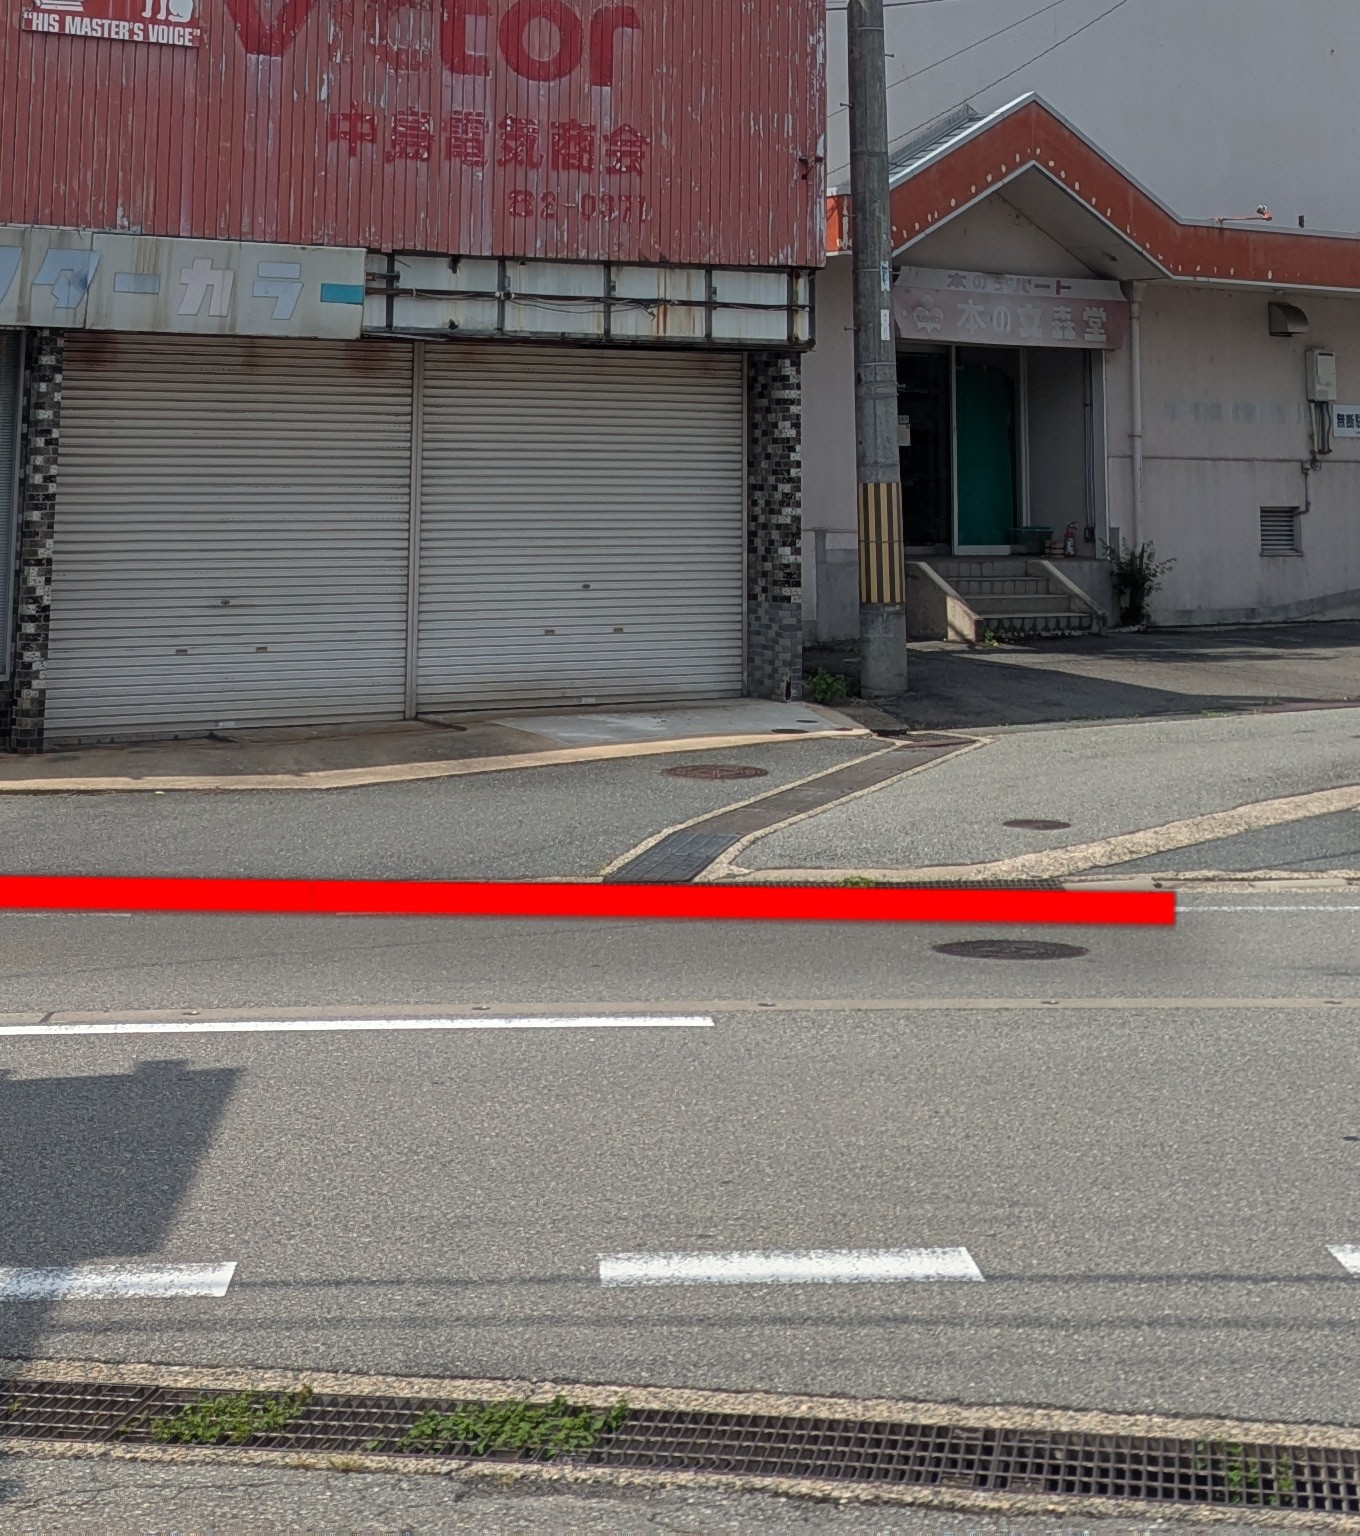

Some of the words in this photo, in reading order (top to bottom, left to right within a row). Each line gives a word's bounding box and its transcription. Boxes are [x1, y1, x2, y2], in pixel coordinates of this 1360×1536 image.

[329, 100, 651, 177] 中島電気商会
